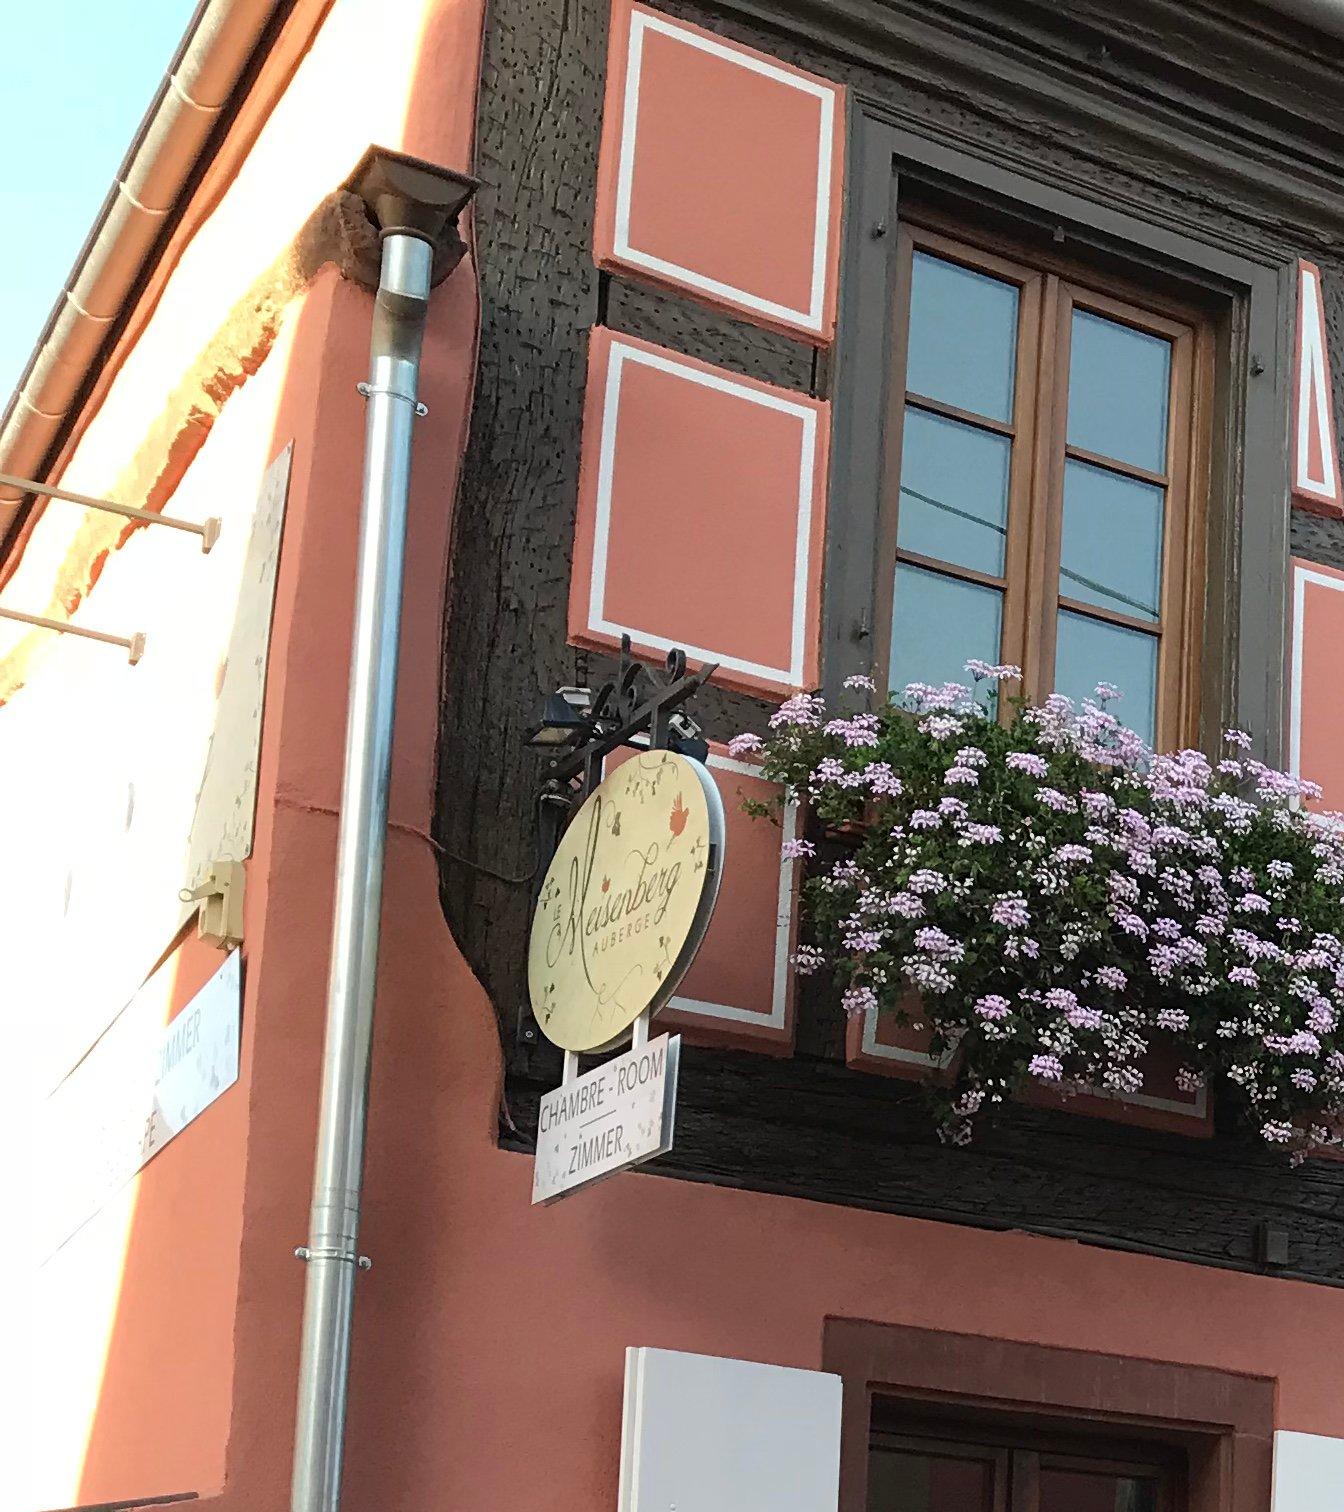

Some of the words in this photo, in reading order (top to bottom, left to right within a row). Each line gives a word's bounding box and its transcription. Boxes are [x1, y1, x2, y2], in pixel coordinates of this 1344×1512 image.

[547, 794, 682, 1000] Meisenberg
[592, 912, 651, 958] AUBERGE
[540, 1076, 606, 1133] CHAMBRE
[617, 1047, 664, 1097] ROOM
